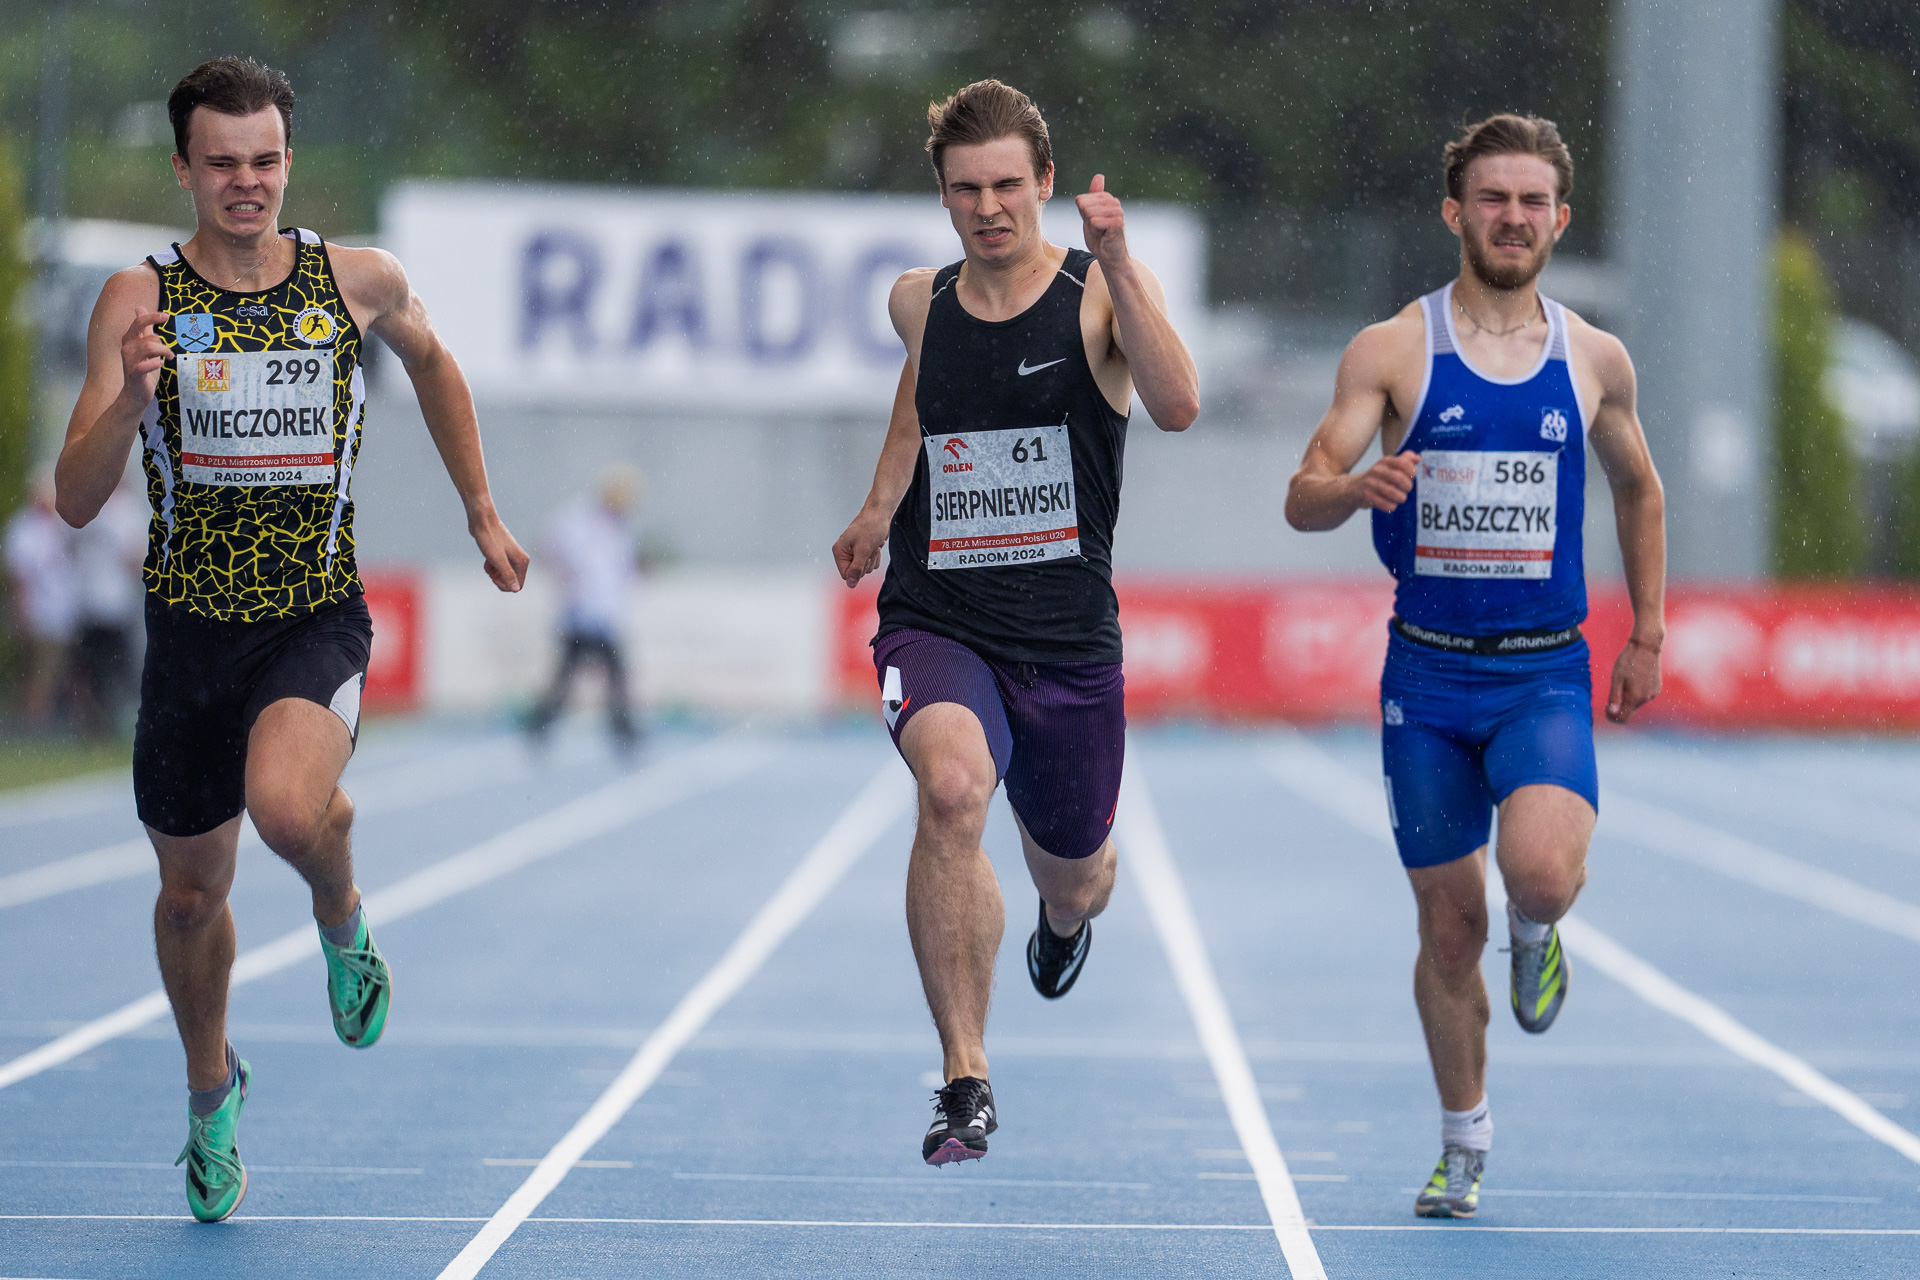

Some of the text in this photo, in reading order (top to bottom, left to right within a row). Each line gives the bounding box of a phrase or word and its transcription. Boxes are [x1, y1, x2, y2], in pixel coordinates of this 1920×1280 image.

[517, 226, 936, 367] RADO
[266, 358, 321, 385] 299
[186, 407, 328, 439] WIECZOREK
[195, 455, 323, 466] 78. PZLA Mistrzostwa Polski U20
[1012, 436, 1048, 463] 61
[214, 471, 303, 482] RADOM 2024
[942, 462, 973, 473] ORLEN
[1494, 460, 1545, 484] 586
[935, 481, 1071, 522] SIERPNIEWSKI
[1421, 502, 1551, 533] BŁASZCZYK
[941, 530, 1066, 549] 78. PZLA Mistrzostwa Polski U20
[959, 548, 1046, 565] RADOM 2024
[1443, 563, 1524, 574] RADOM 2024
